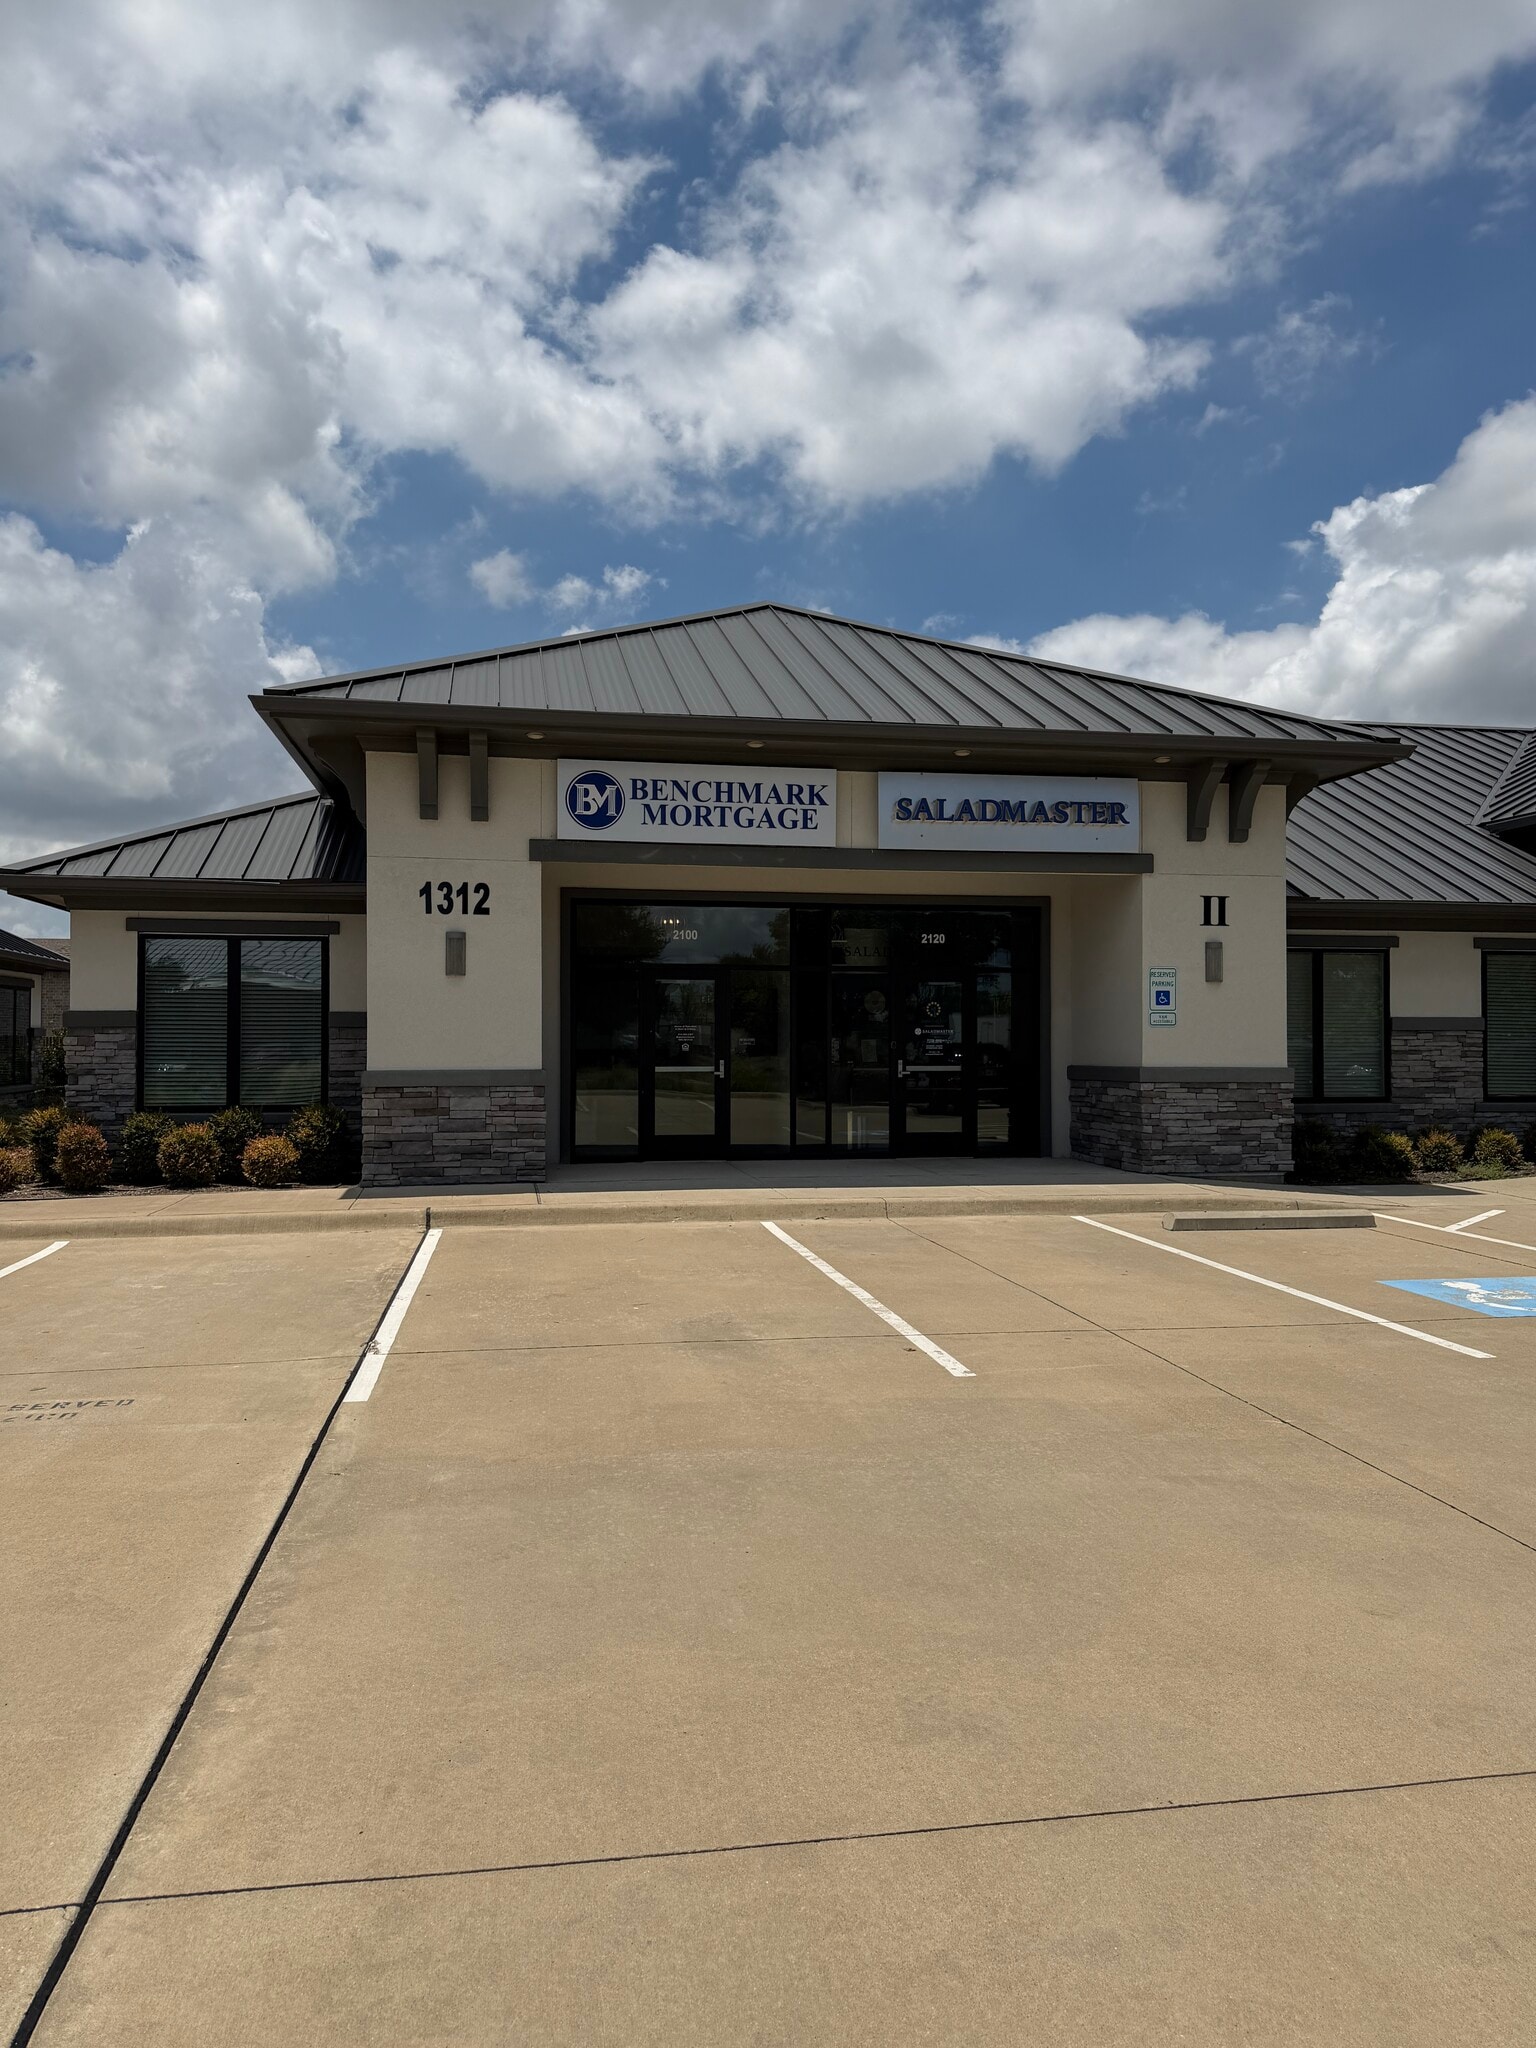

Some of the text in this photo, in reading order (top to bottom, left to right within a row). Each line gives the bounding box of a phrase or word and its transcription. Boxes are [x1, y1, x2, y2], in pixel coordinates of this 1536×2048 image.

[629, 778, 829, 807] BENCHMARK
[641, 803, 819, 830] MORTGAGE
[895, 797, 1130, 825] SALADMASTER
[419, 881, 490, 915] 1312
[1199, 895, 1230, 927] II
[672, 930, 698, 940] 2100
[921, 933, 946, 944] 2120
